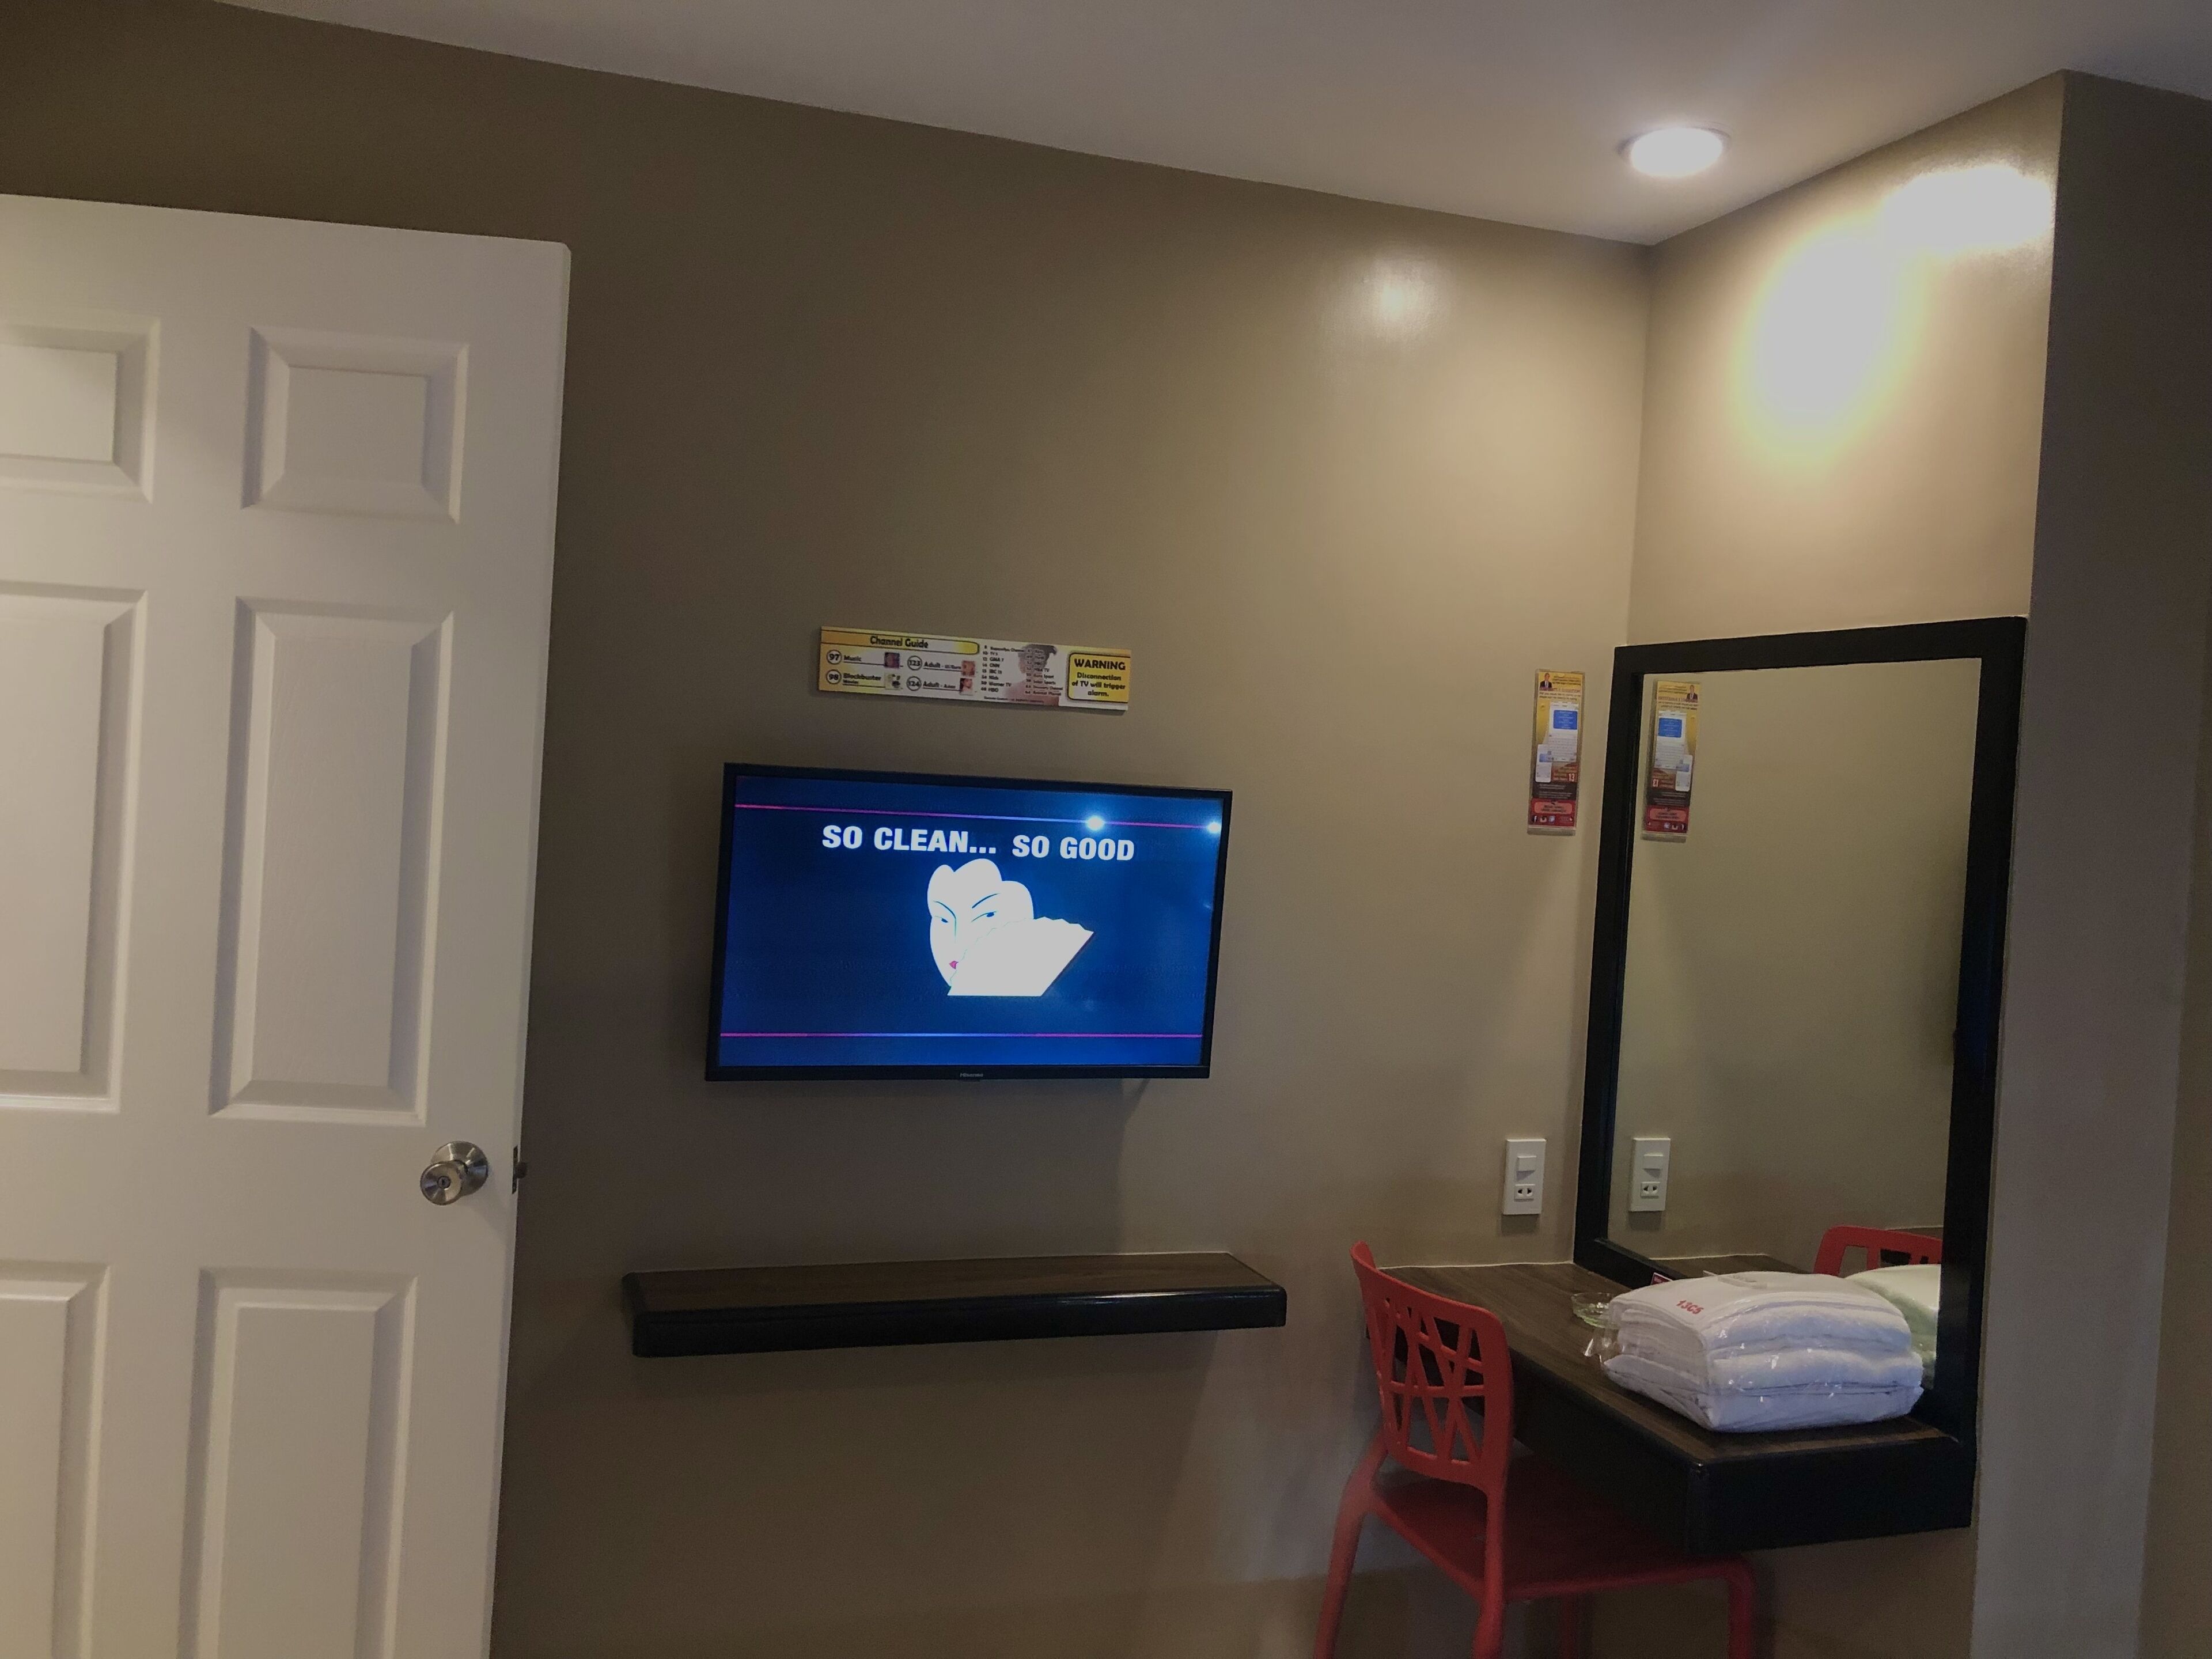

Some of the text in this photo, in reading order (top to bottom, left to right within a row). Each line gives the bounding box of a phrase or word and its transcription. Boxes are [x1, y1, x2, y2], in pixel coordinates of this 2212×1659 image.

[870, 636, 929, 649] Channel Guide
[1074, 658, 1126, 671] WARNING
[843, 673, 881, 681] Blockbuster
[1077, 672, 1122, 681] Disconnection
[822, 825, 1135, 861] SO CLEAN... SO GOOD
